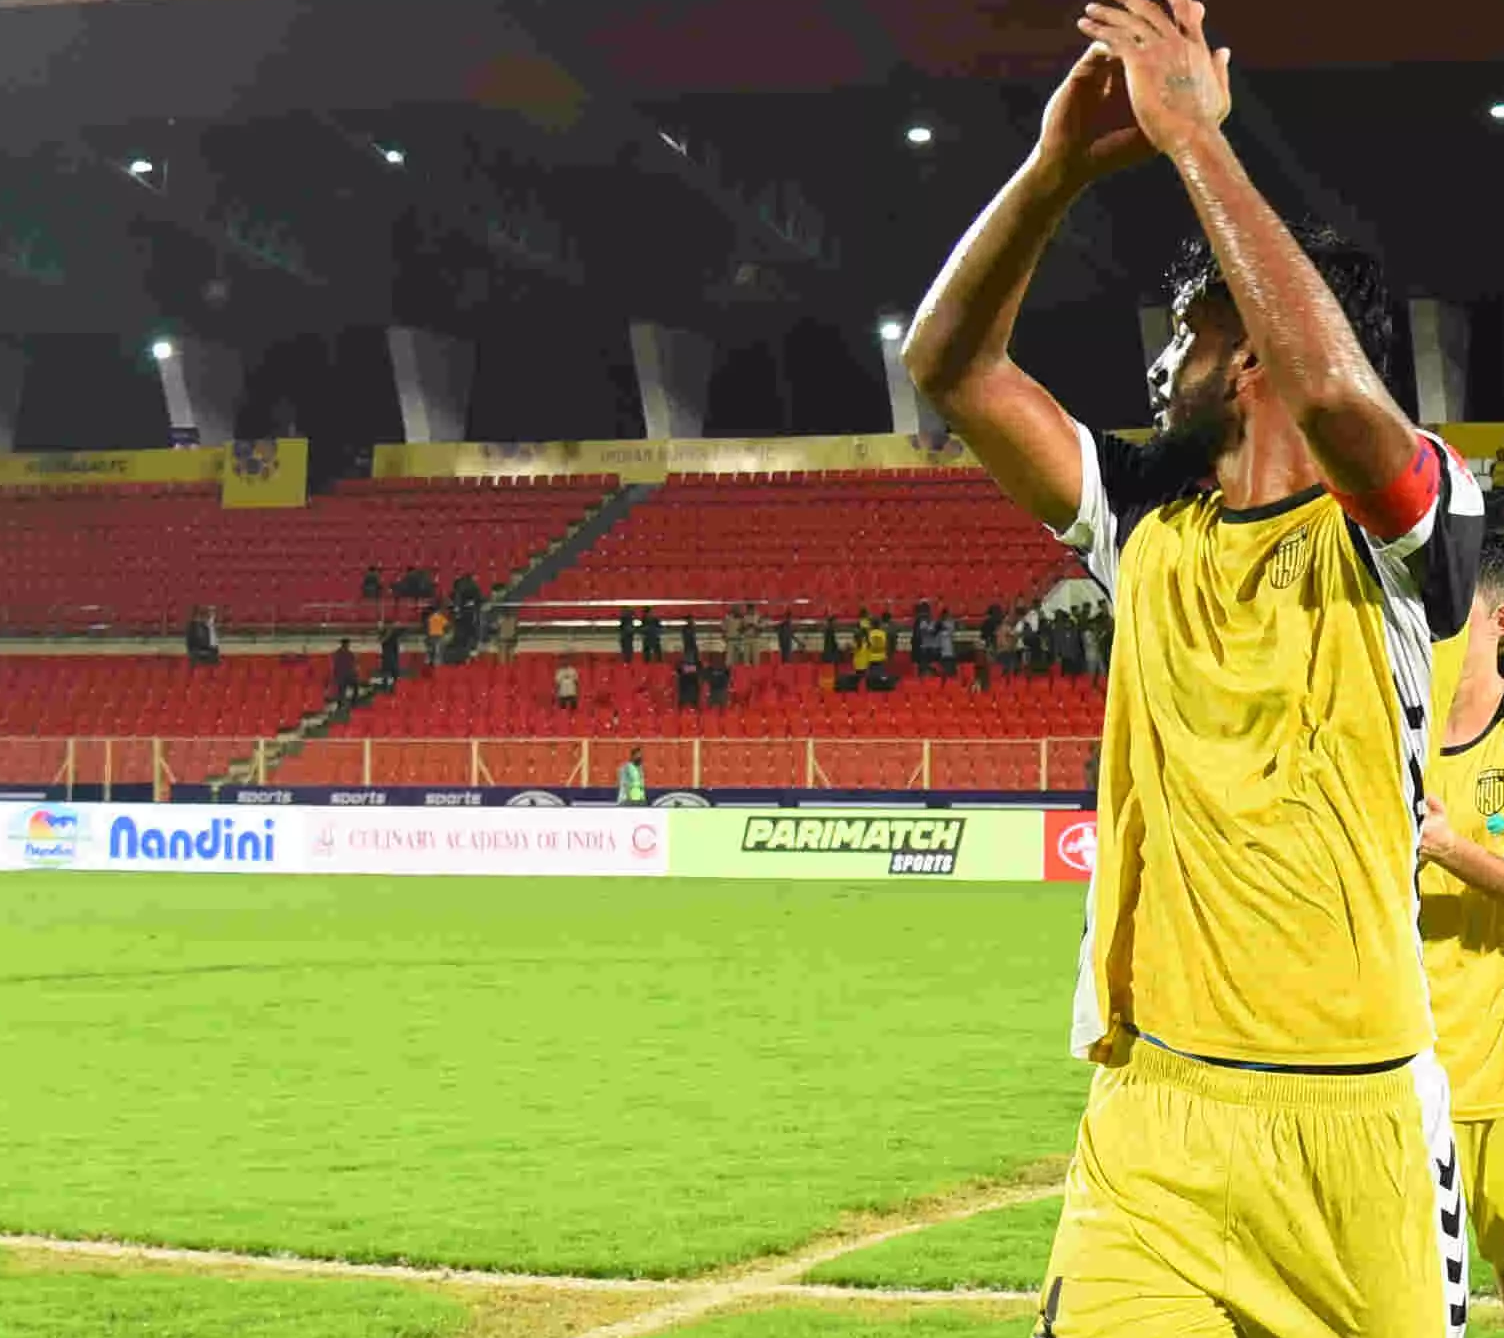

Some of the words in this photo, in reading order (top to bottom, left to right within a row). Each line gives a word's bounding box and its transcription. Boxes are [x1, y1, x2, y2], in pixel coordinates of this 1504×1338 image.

[237, 790, 292, 805] sports
[331, 790, 386, 805] sports
[425, 791, 481, 806] sports
[349, 828, 435, 850] CULINARY
[445, 829, 531, 851] ACADEMY
[535, 830, 561, 851] OF
[566, 830, 617, 852] INDIA
[744, 819, 961, 850] PARIMATCH
[892, 853, 954, 872] SPORTS
